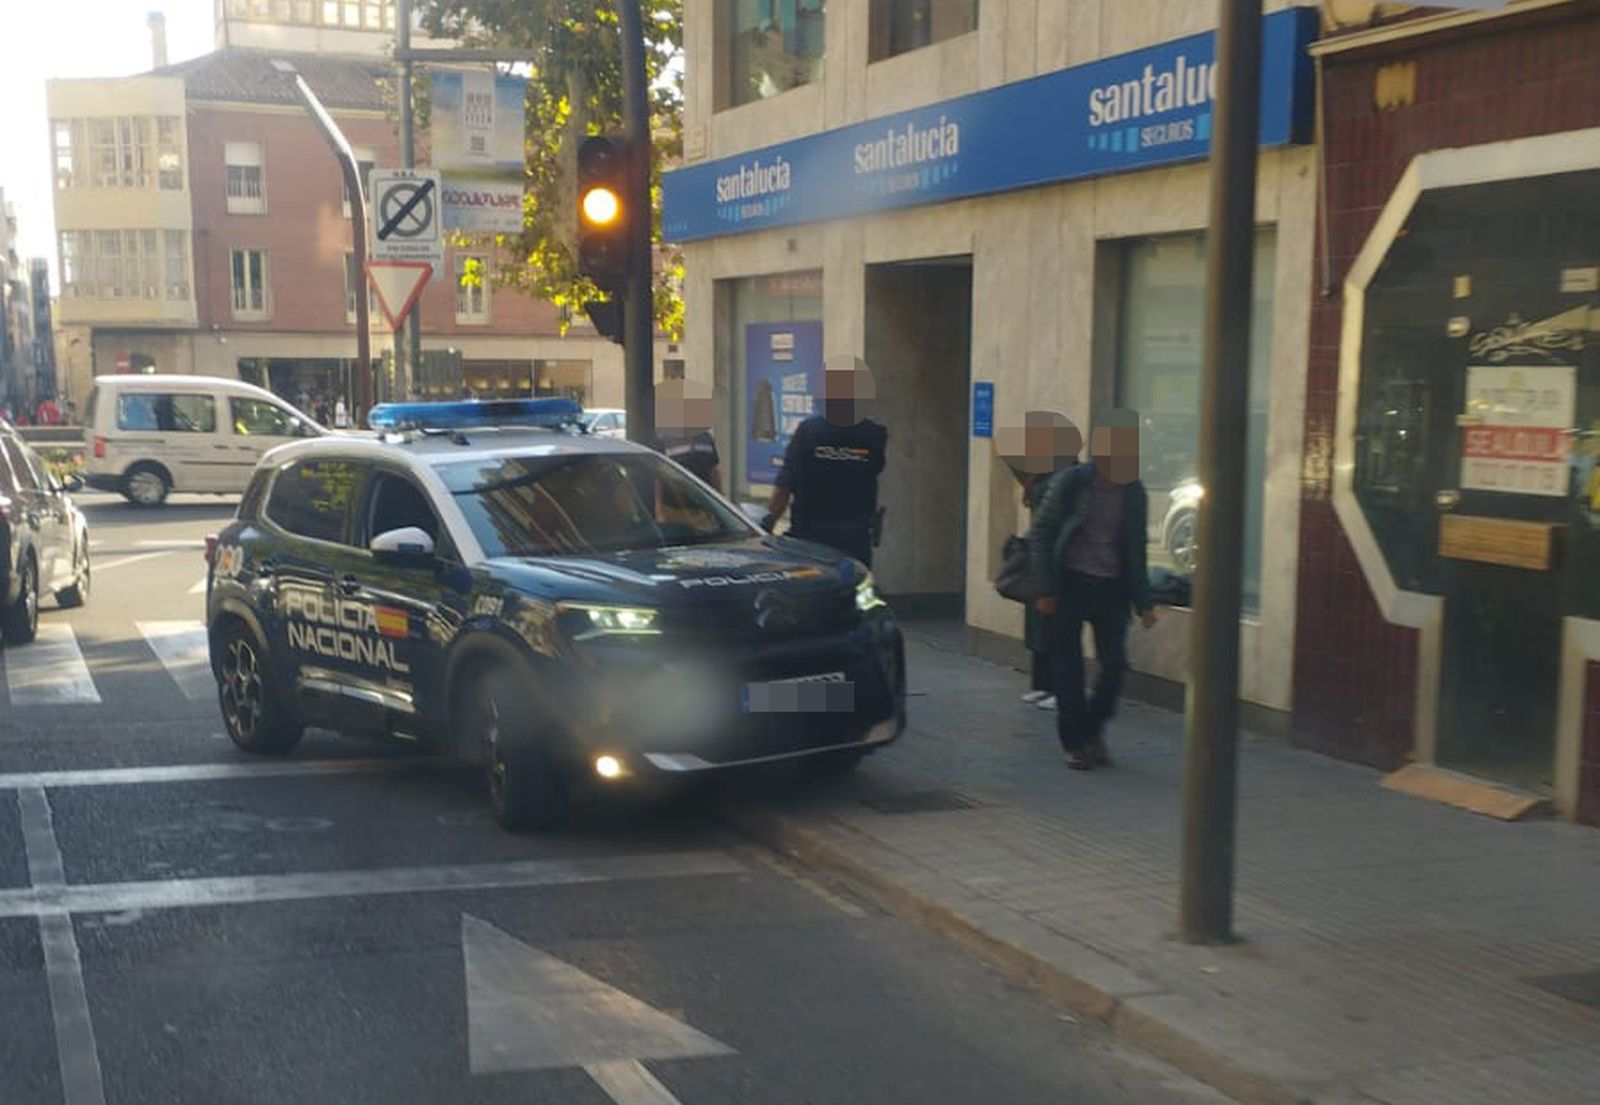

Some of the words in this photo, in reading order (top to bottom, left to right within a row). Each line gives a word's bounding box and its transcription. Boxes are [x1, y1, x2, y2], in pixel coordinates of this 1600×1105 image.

[854, 115, 959, 175] santalucía
[284, 590, 380, 634] POLICIA
[287, 620, 411, 674] NACIONAL
